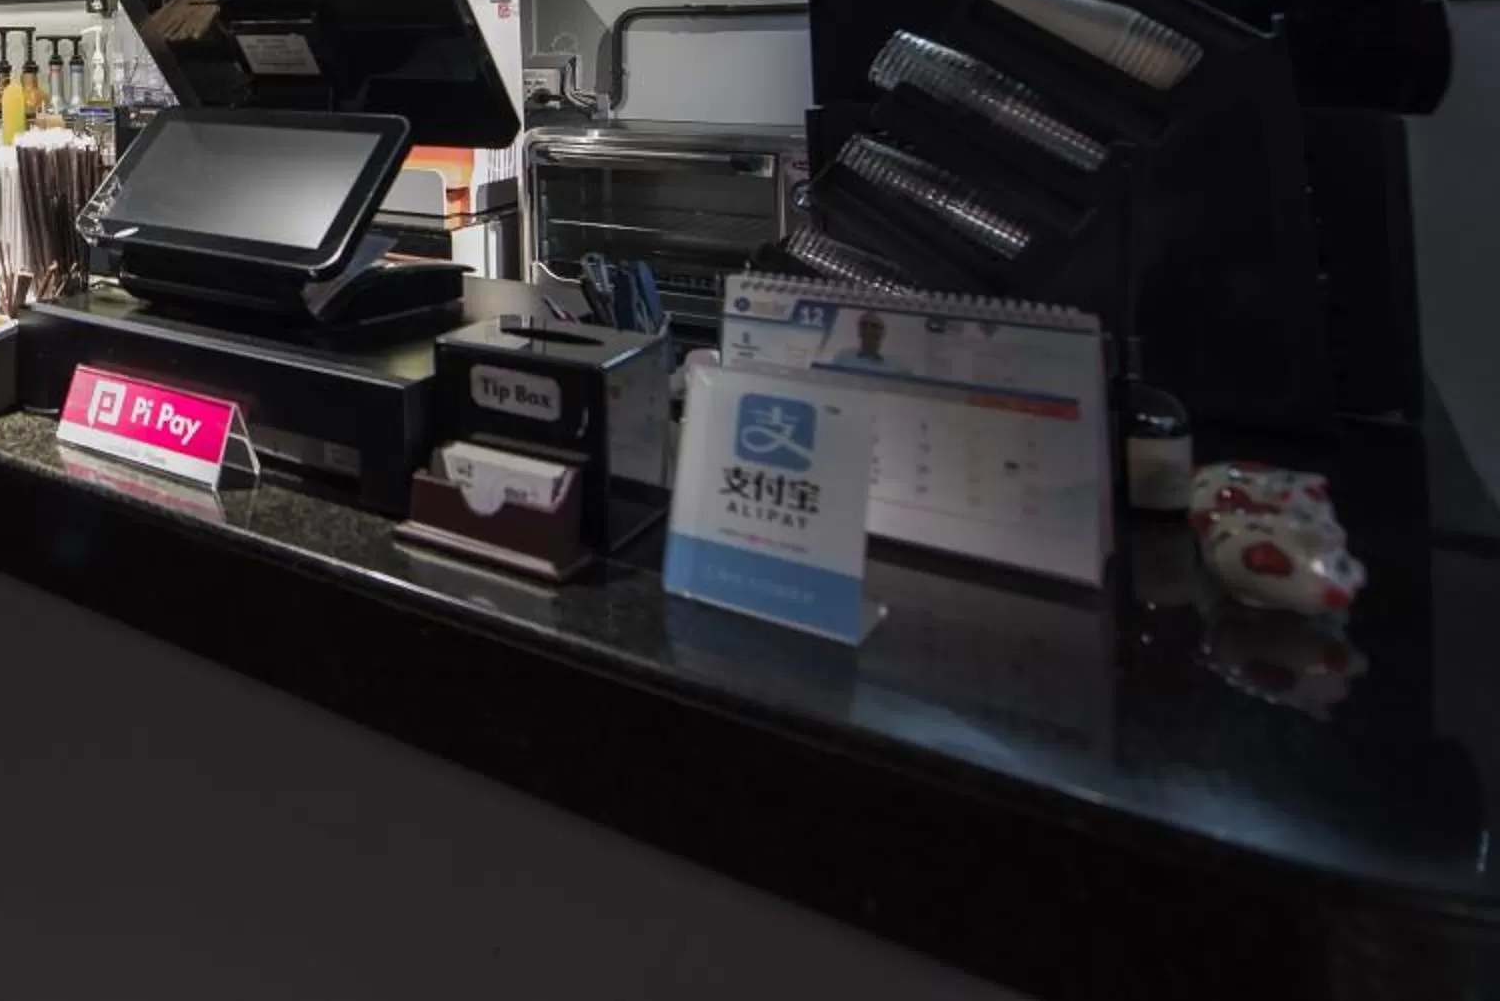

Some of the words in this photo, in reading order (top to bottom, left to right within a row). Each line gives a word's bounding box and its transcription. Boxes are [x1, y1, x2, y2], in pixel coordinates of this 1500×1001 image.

[799, 306, 825, 328] 12
[479, 375, 511, 404] Tip
[515, 381, 553, 409] Box
[131, 396, 155, 427] Pi
[156, 403, 203, 446] Pay
[720, 466, 821, 514] 支付宝
[726, 498, 810, 531] ALIPAY
